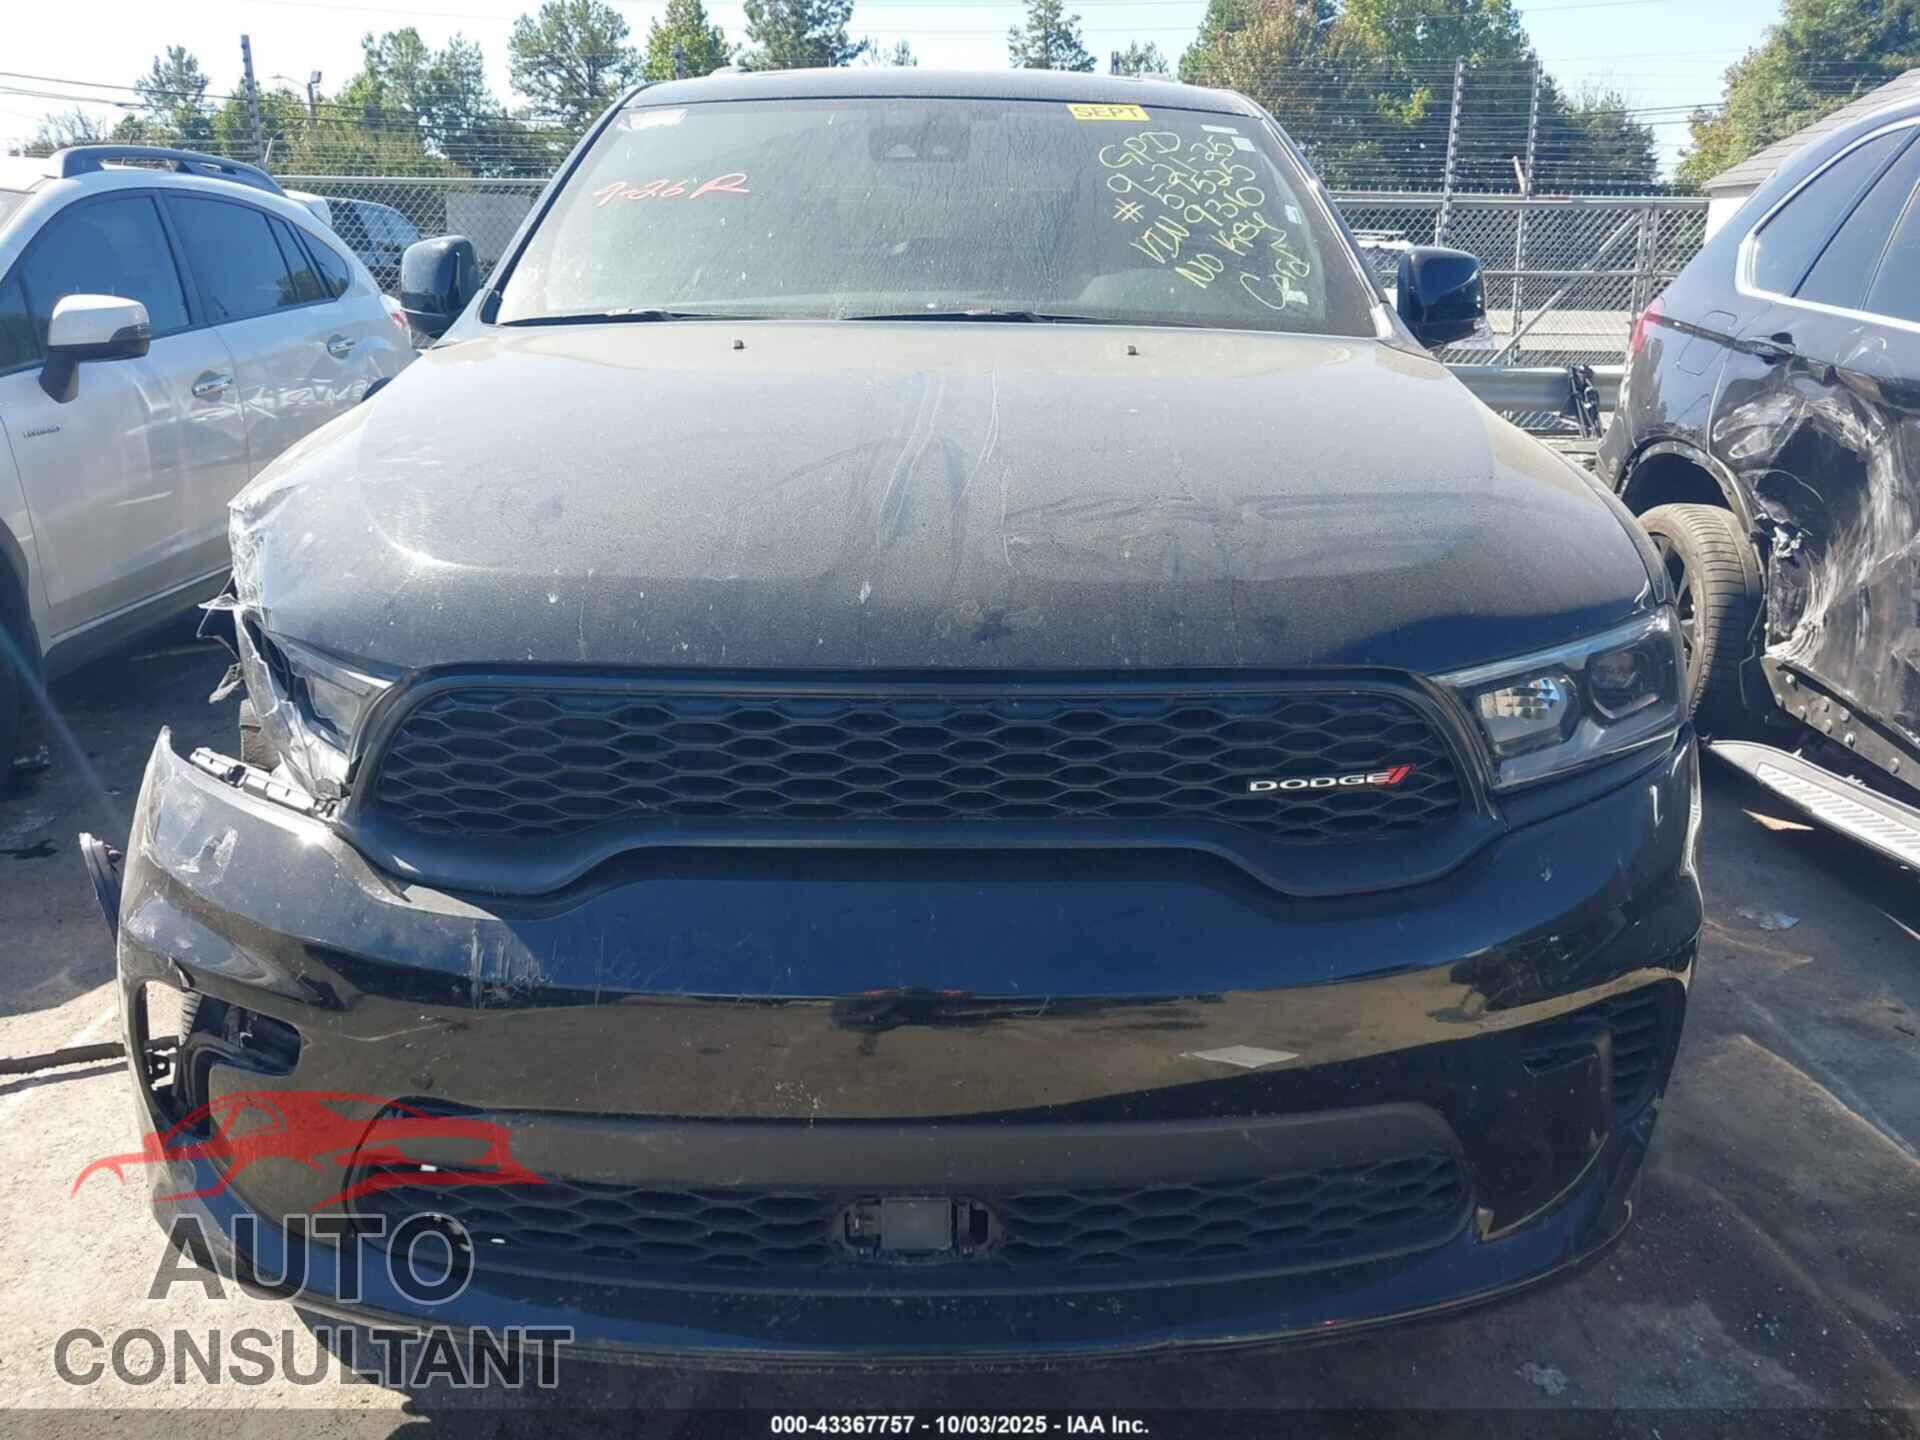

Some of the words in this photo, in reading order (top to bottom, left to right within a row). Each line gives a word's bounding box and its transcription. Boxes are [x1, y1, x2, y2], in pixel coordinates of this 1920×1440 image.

[1073, 106, 1138, 118] SEPT
[689, 172, 750, 199] R
[1112, 198, 1145, 223] #
[1129, 216, 1190, 264] VIN
[1249, 771, 1391, 792] DODGE
